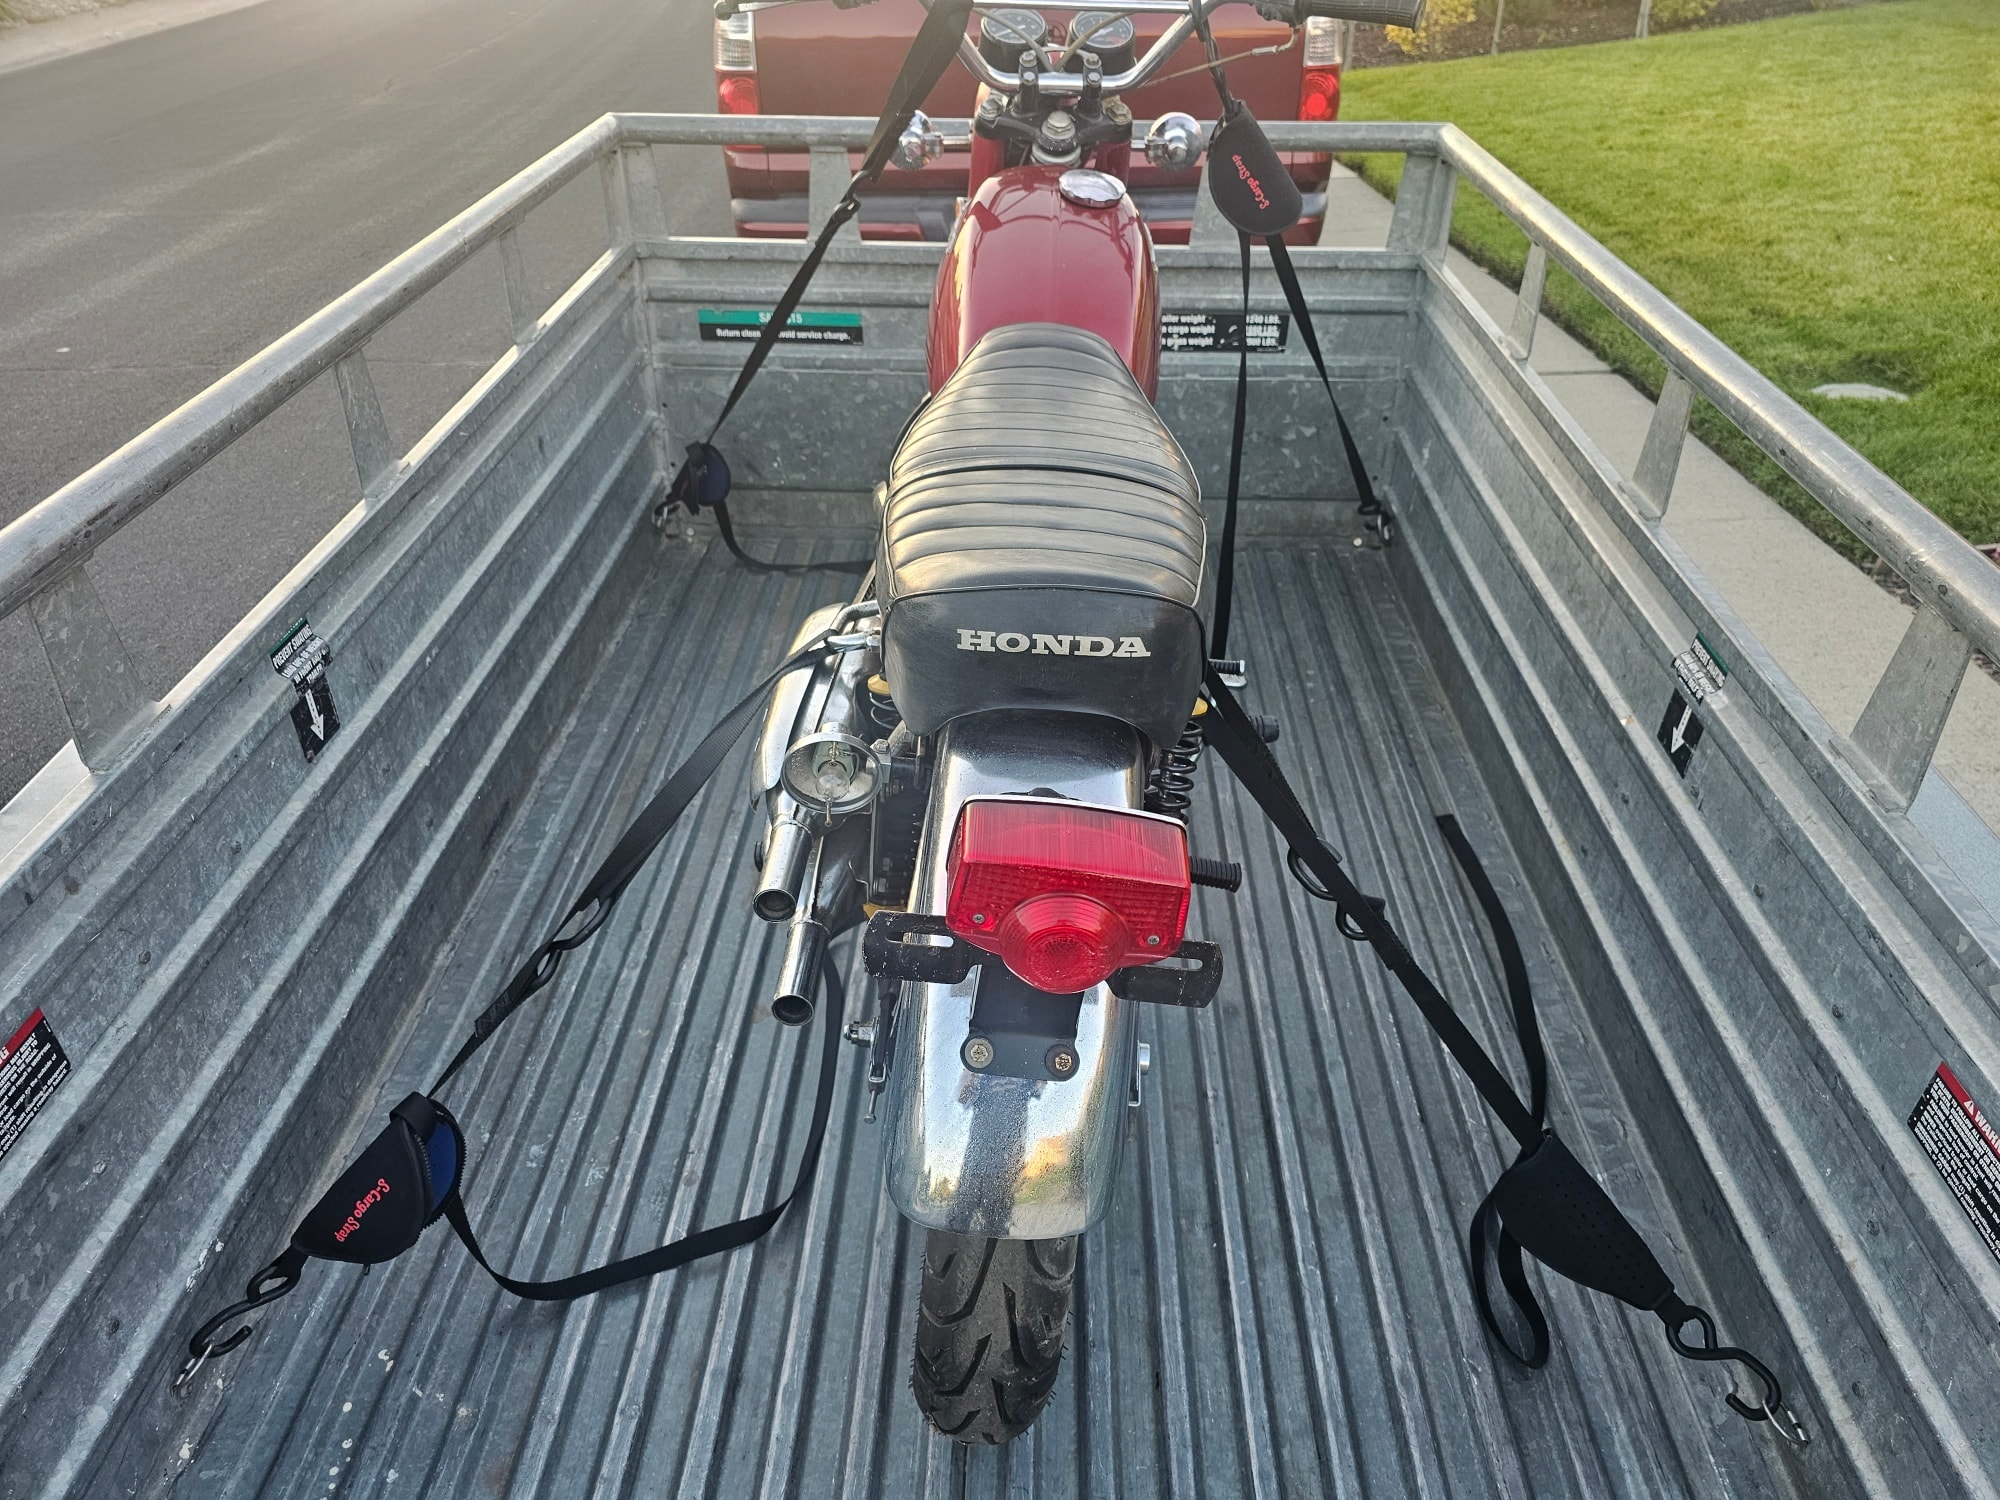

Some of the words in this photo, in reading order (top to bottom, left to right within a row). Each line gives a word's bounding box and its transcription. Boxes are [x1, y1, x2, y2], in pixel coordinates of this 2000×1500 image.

[956, 628, 1151, 658] HONDA
[353, 1178, 391, 1219] S-Cargo
[334, 1215, 361, 1243] Strap
